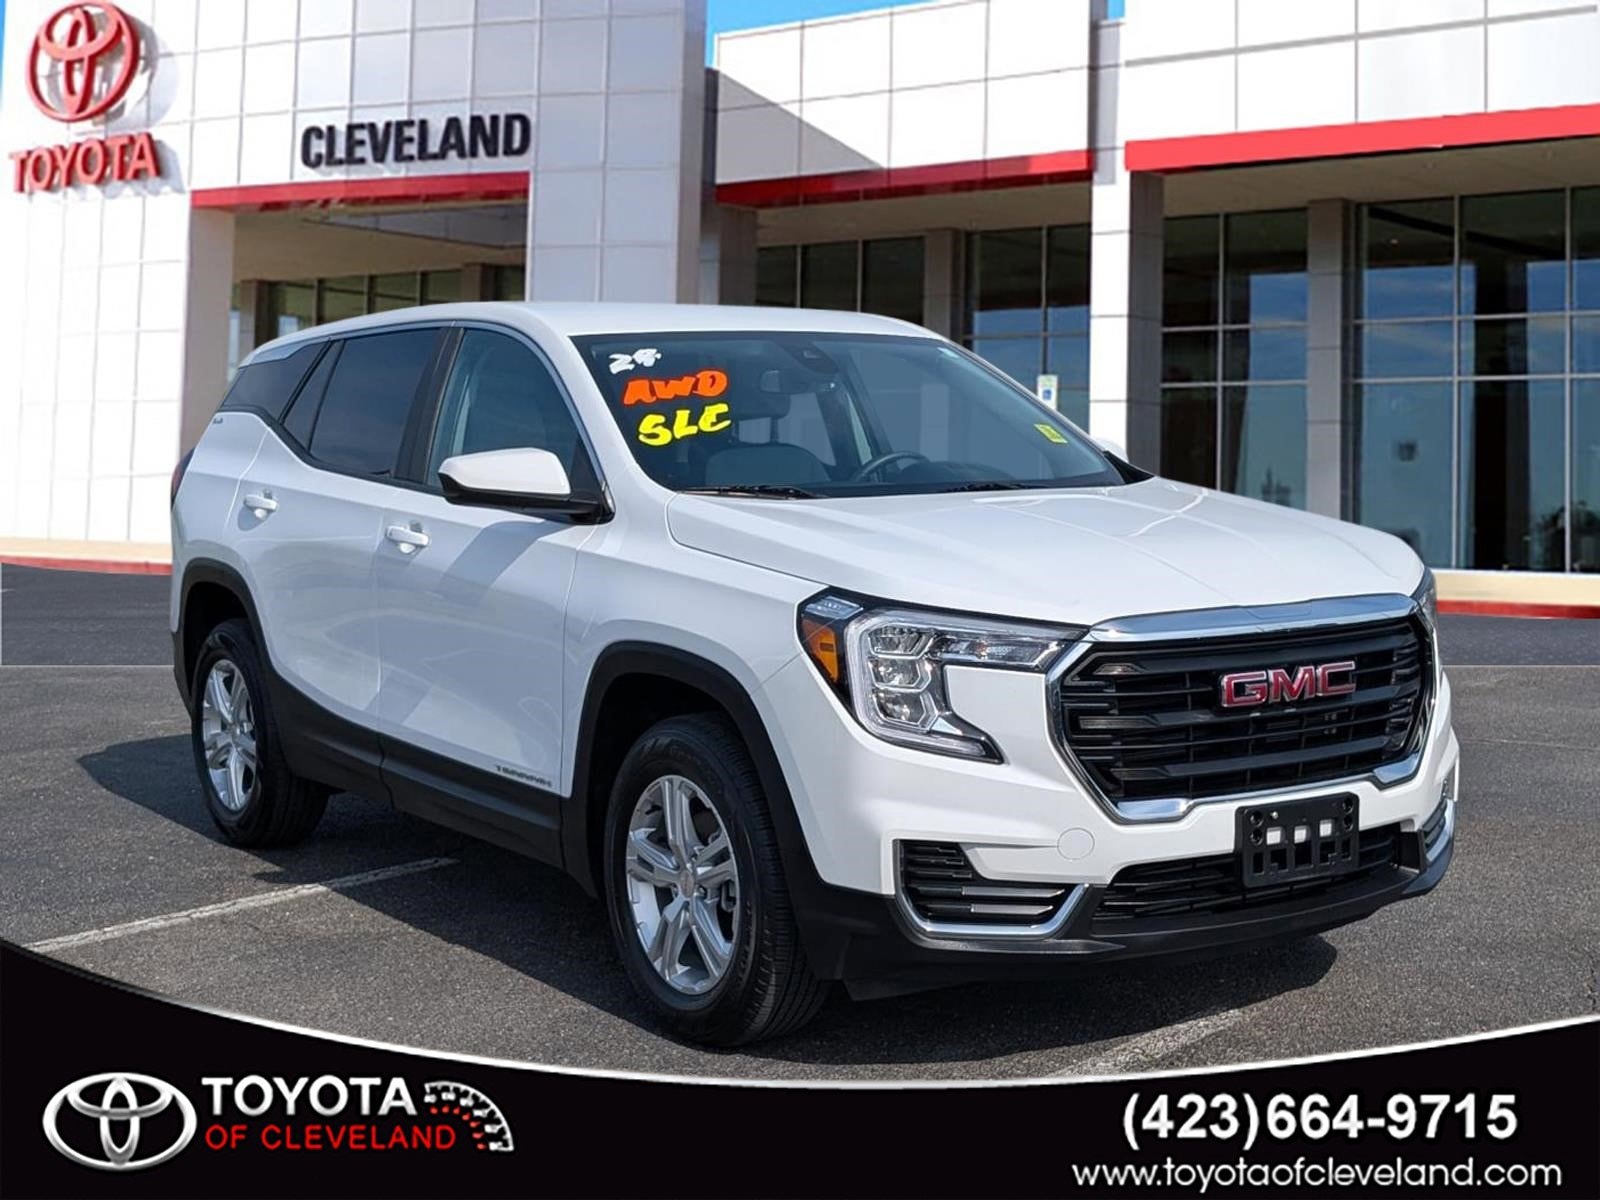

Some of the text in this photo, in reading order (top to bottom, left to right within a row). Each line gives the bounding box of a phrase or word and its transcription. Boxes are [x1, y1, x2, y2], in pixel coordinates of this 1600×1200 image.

[9, 131, 161, 193] TOYOTA
[300, 112, 532, 170] CLEVELAND
[623, 369, 729, 406] AWD
[638, 402, 731, 446] SLE
[1220, 660, 1356, 708] GMC
